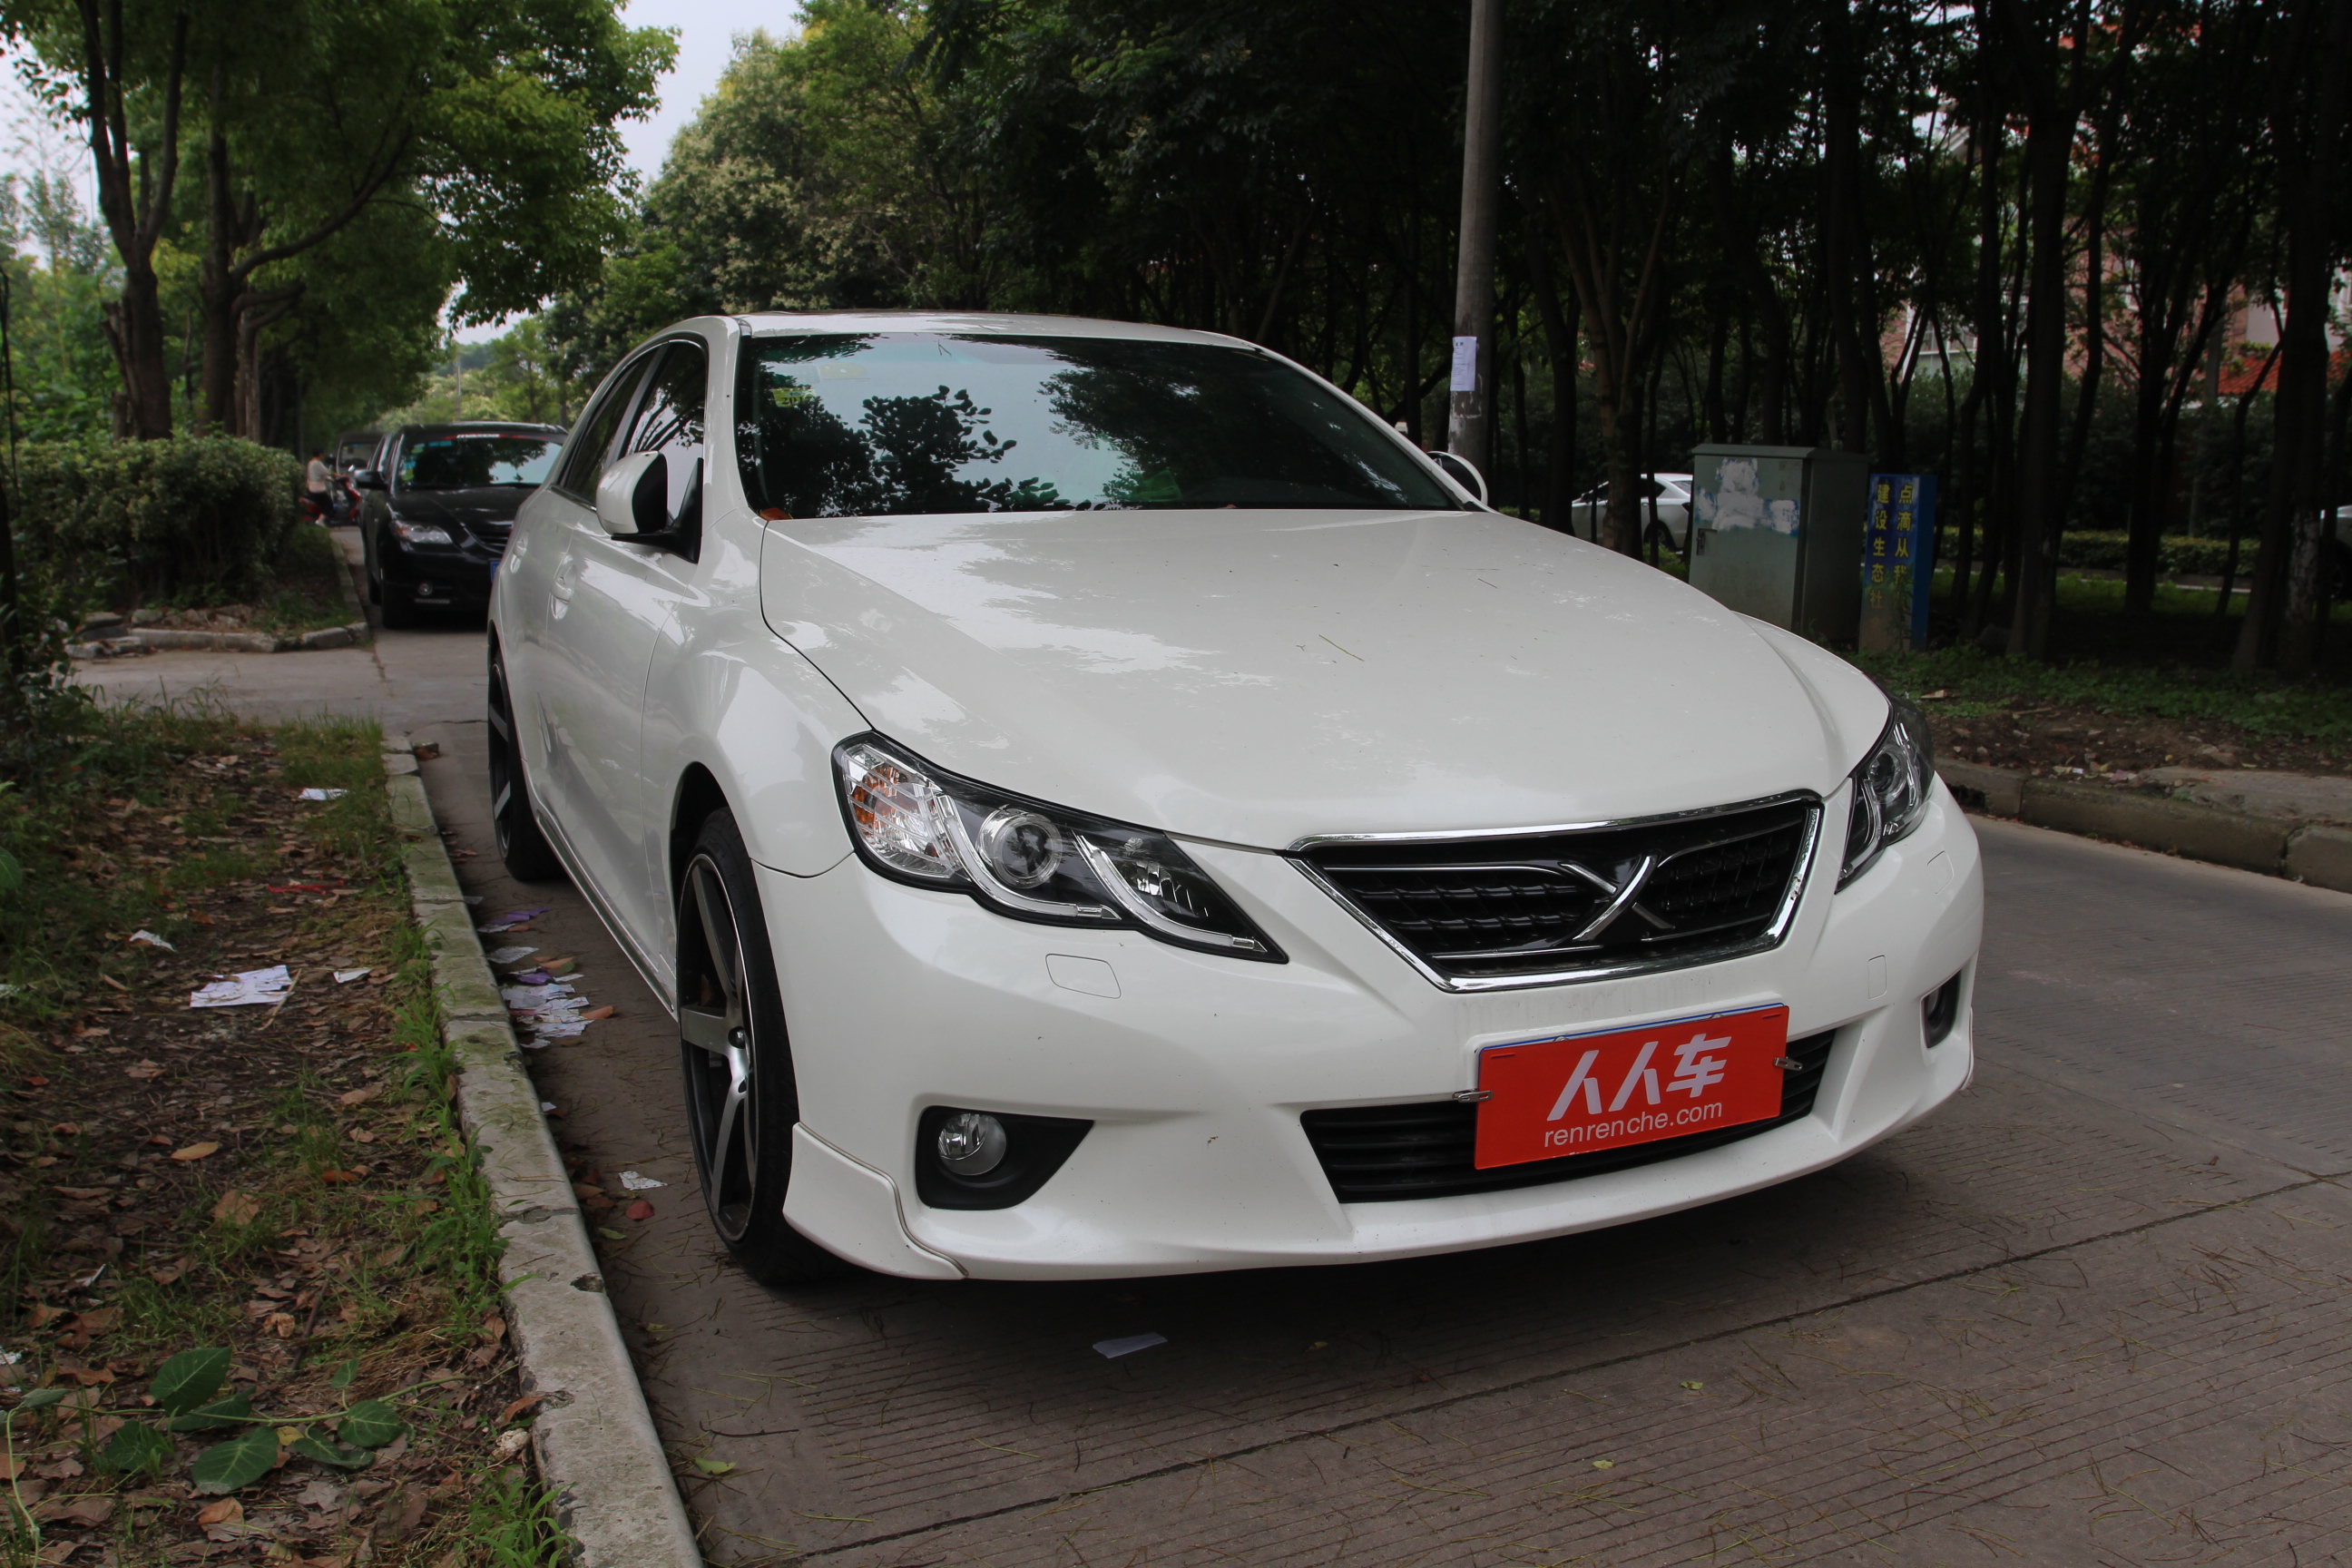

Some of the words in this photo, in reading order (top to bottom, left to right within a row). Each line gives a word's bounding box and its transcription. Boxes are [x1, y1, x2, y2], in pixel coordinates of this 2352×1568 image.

[1869, 483, 1890, 624] 建设生态社
[1893, 483, 1914, 607] 点滴从我
[1544, 1101, 1723, 1148] renrenche.com
[1546, 1033, 1732, 1122] 人人车
